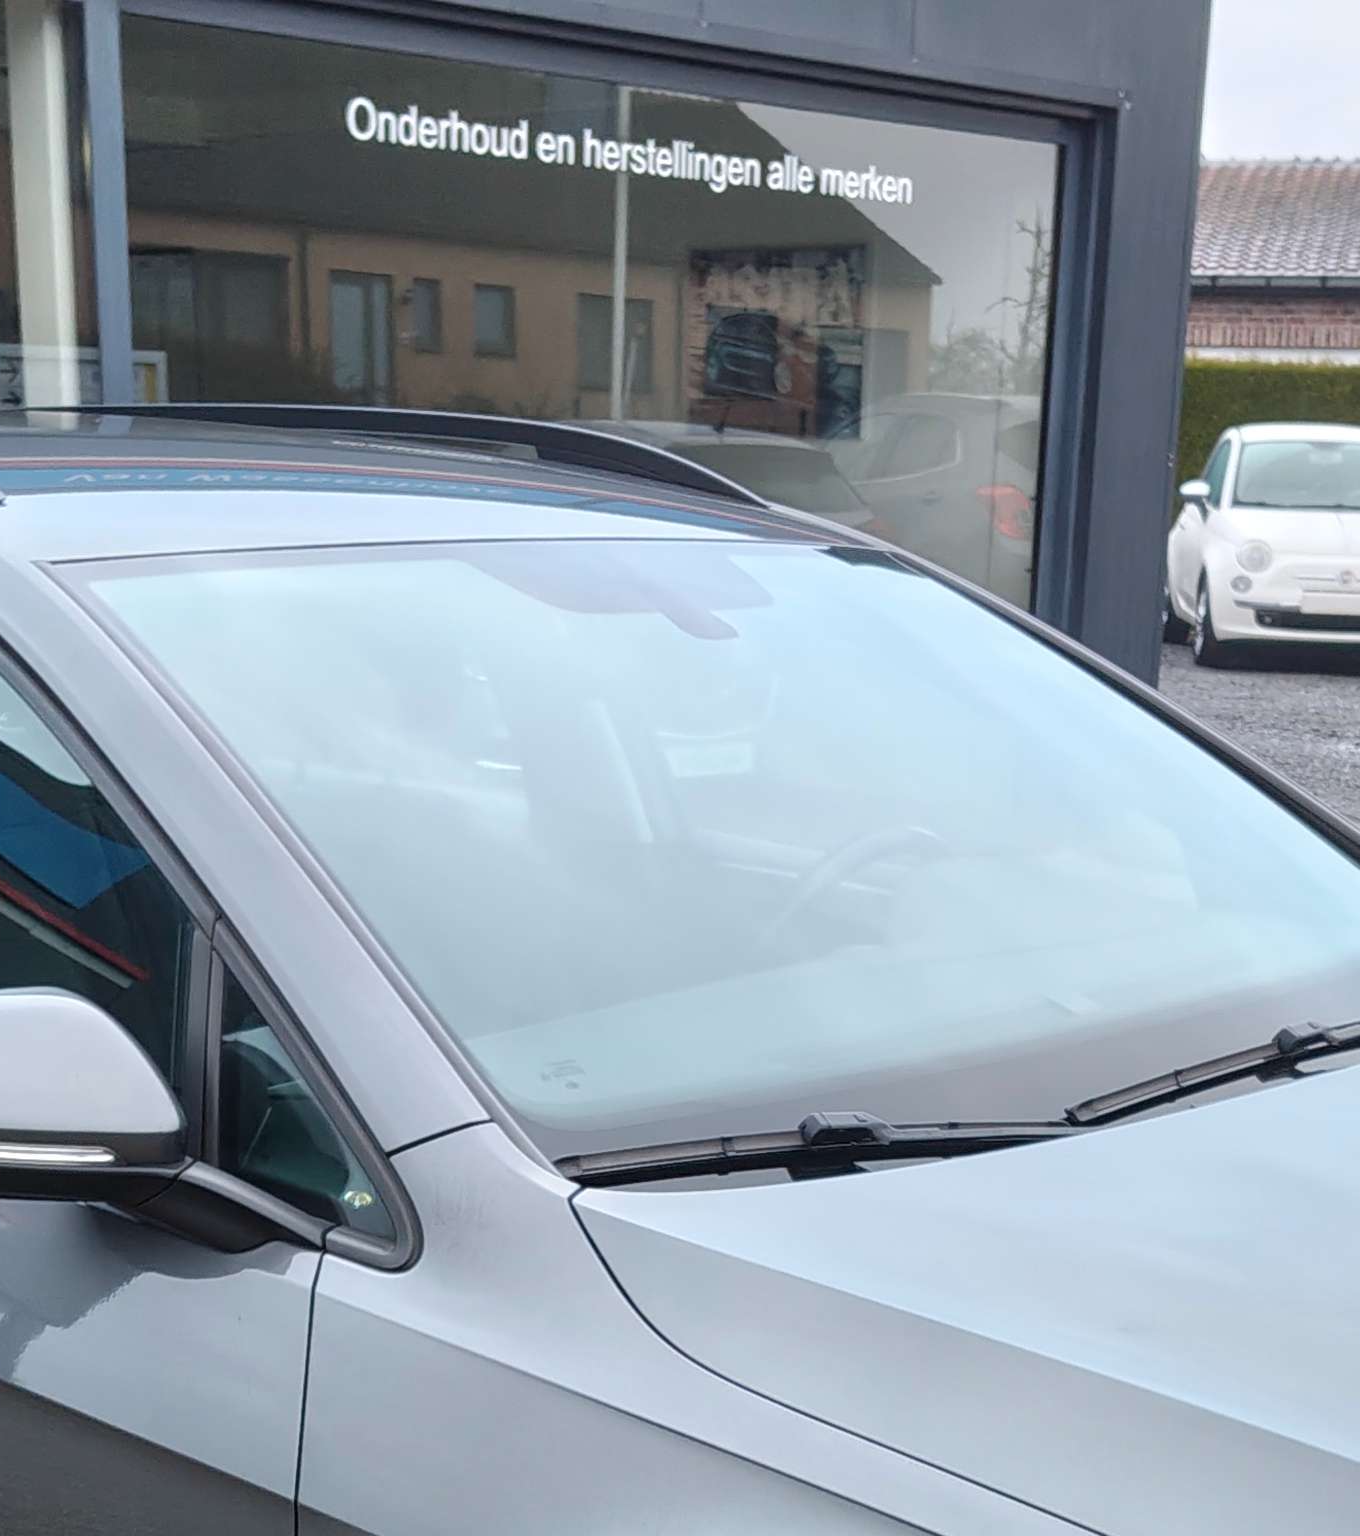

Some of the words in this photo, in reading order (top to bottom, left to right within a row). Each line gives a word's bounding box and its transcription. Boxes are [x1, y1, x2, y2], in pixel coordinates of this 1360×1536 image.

[345, 96, 528, 160] Onderhoud
[535, 130, 575, 166] en
[583, 128, 761, 193] herstellingen
[767, 153, 816, 194] alle
[820, 165, 913, 205] merken
